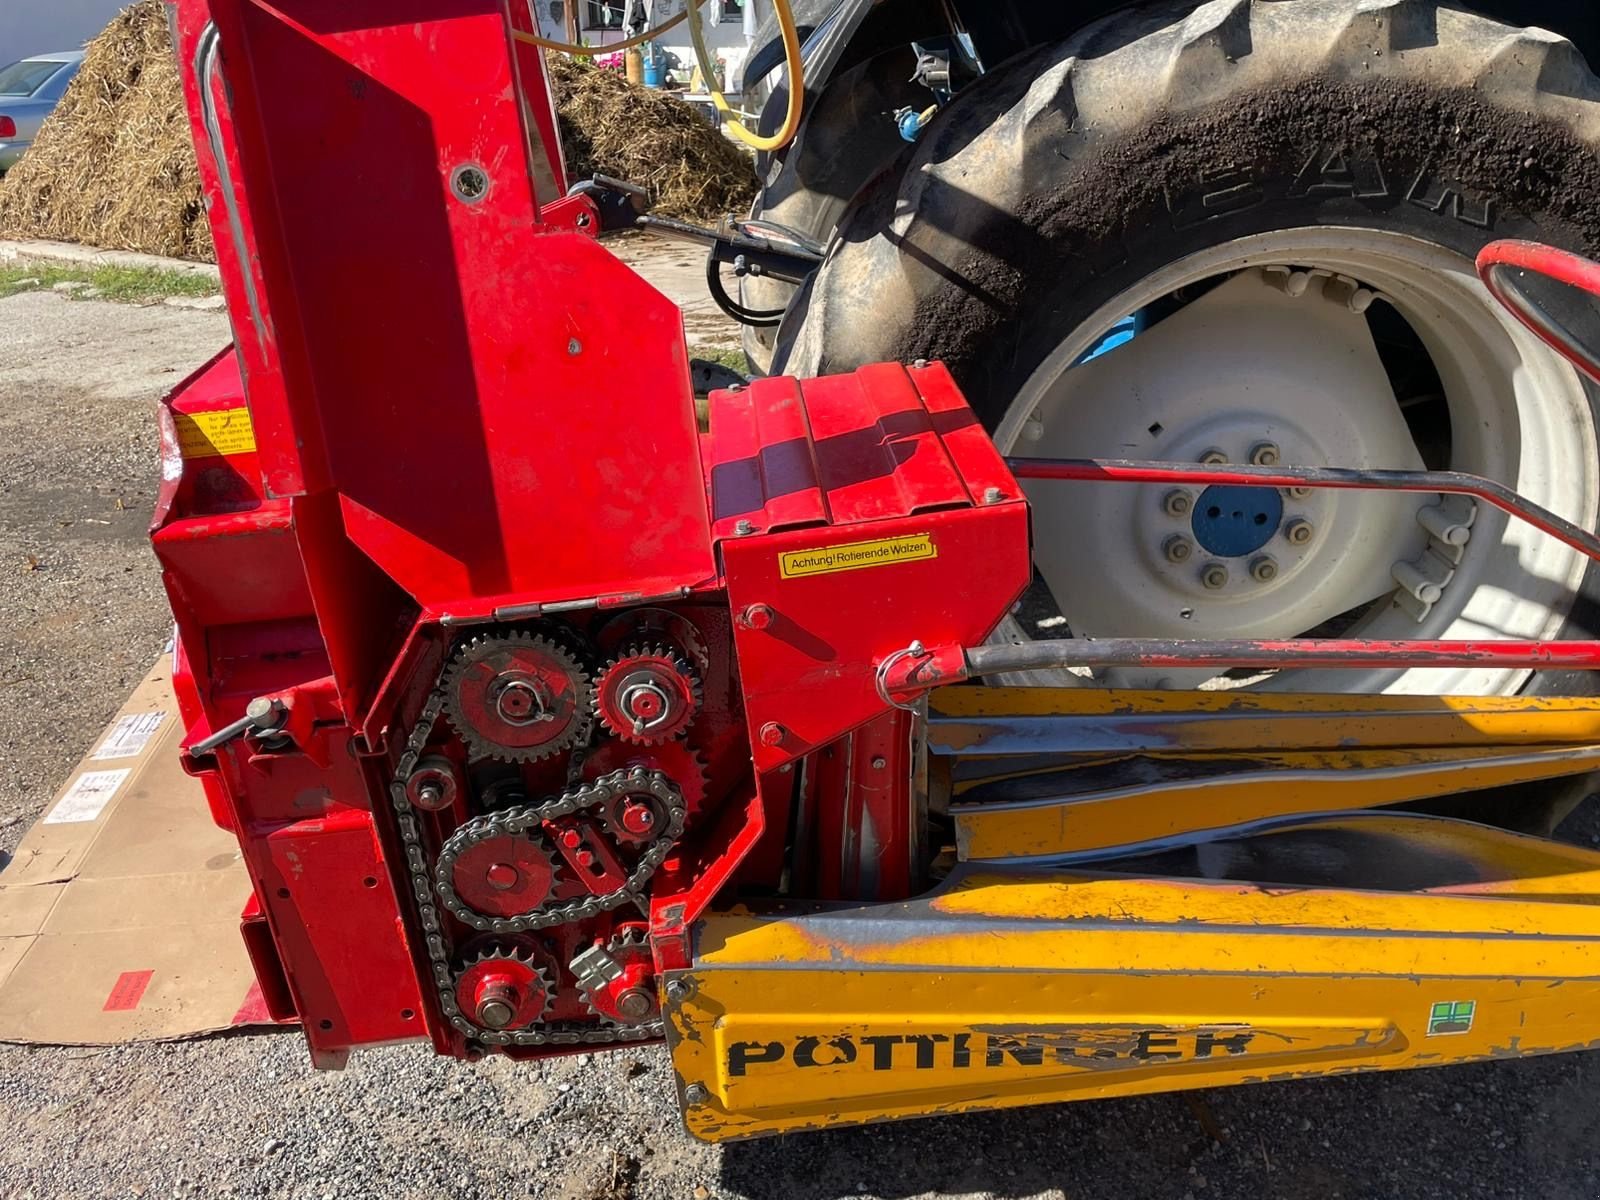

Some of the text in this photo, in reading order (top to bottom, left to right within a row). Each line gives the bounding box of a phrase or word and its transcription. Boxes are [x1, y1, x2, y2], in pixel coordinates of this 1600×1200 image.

[791, 543, 927, 569] Achtung! Rotierende Walzen
